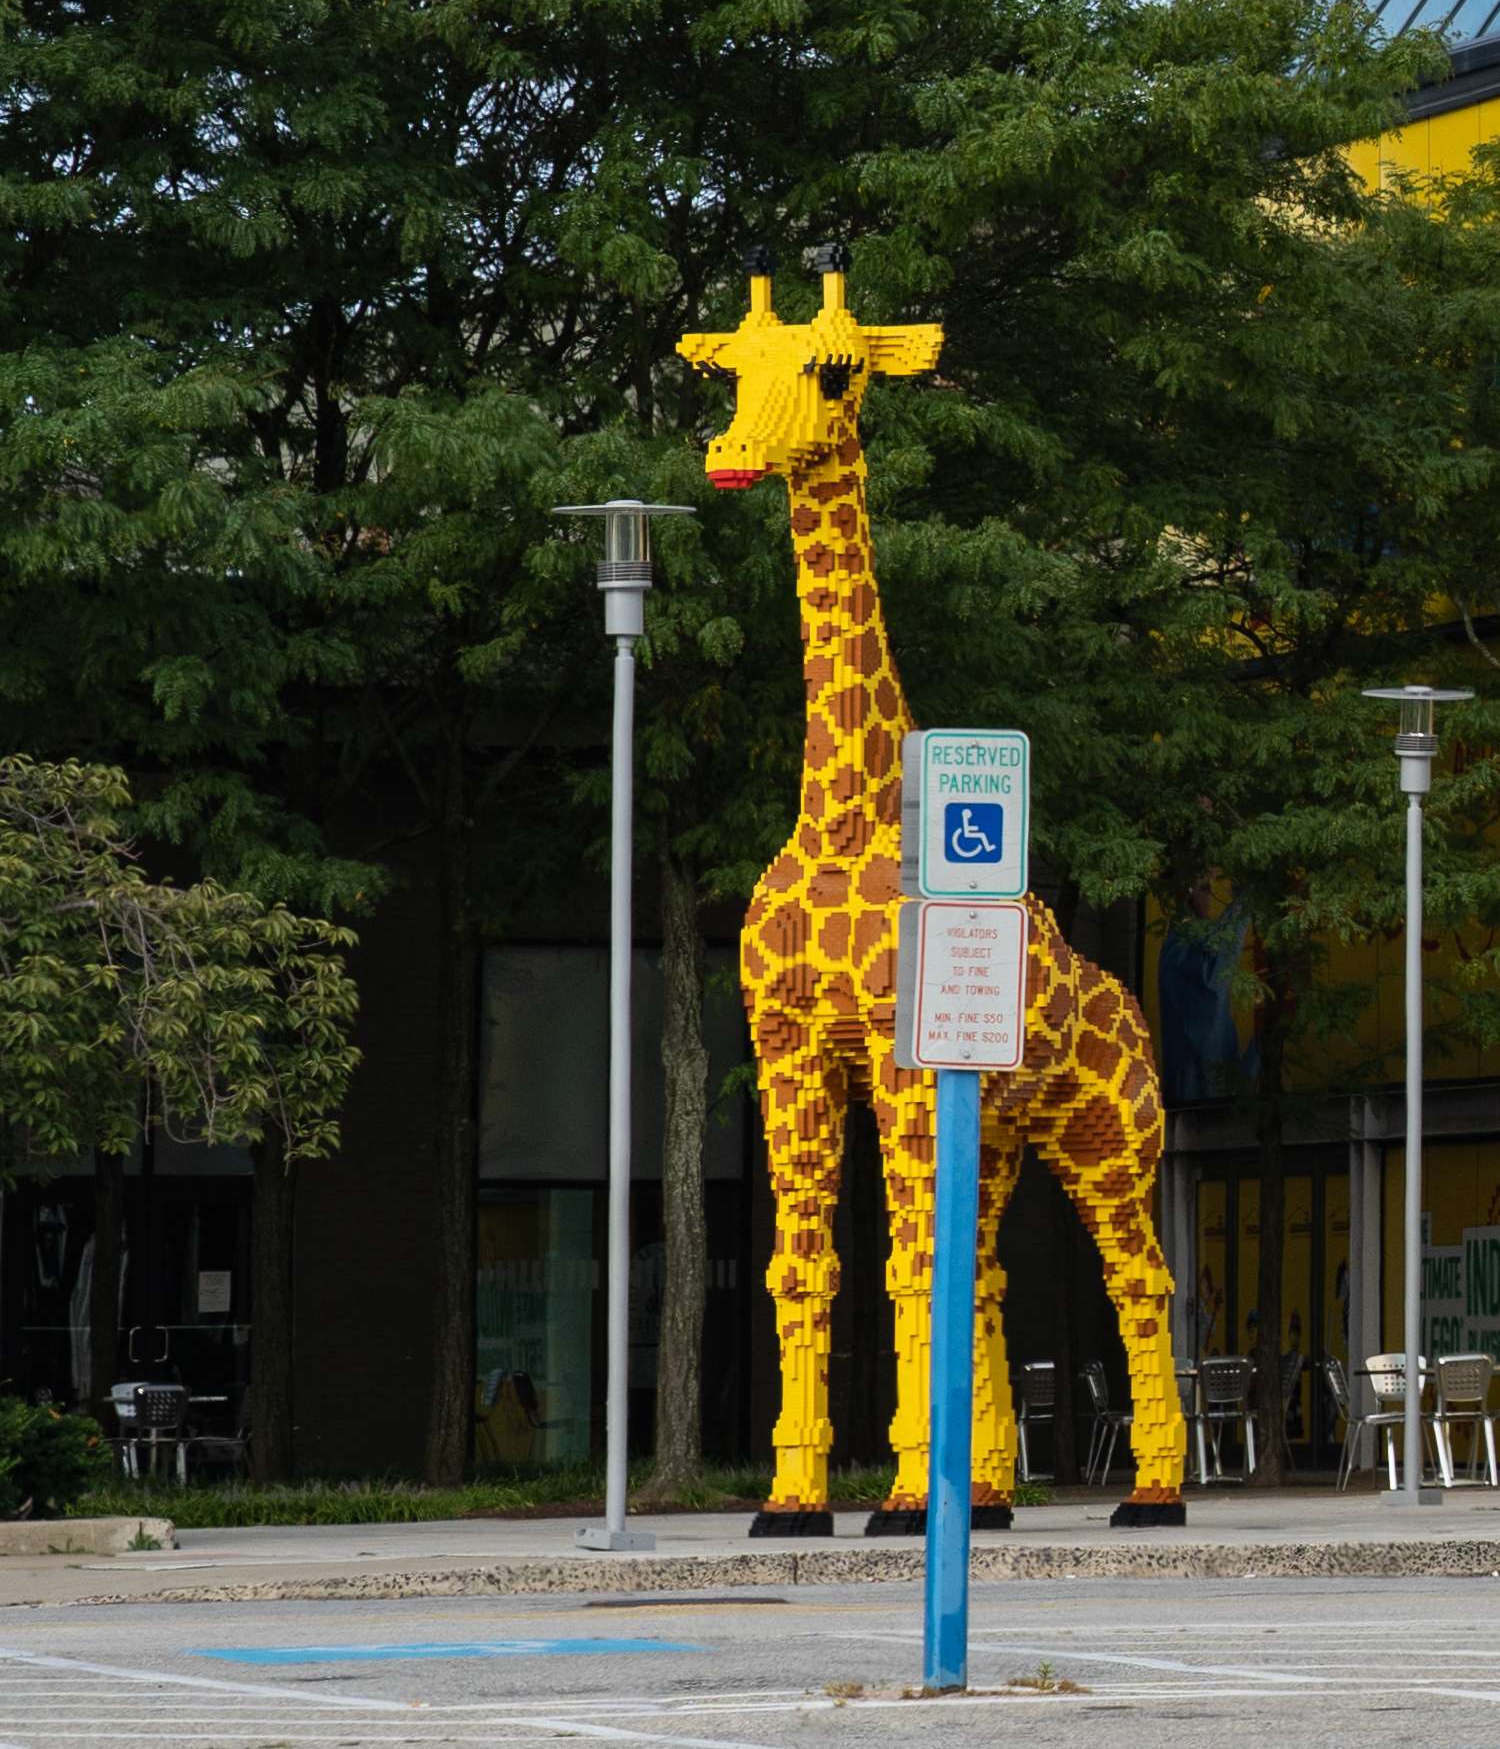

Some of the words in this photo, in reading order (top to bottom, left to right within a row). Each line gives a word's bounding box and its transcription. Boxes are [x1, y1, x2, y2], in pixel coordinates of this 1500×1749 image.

[932, 745, 1021, 767] RESERVED
[939, 774, 1012, 794] PARKING
[947, 928, 998, 939] VIOLATORS
[950, 947, 992, 958] SUBJECT
[953, 966, 965, 977] TO
[969, 966, 989, 977] FINE
[941, 985, 962, 995] AND
[965, 985, 1000, 996] TOWING
[958, 1013, 980, 1024] FINE
[956, 1032, 977, 1043] FINE
